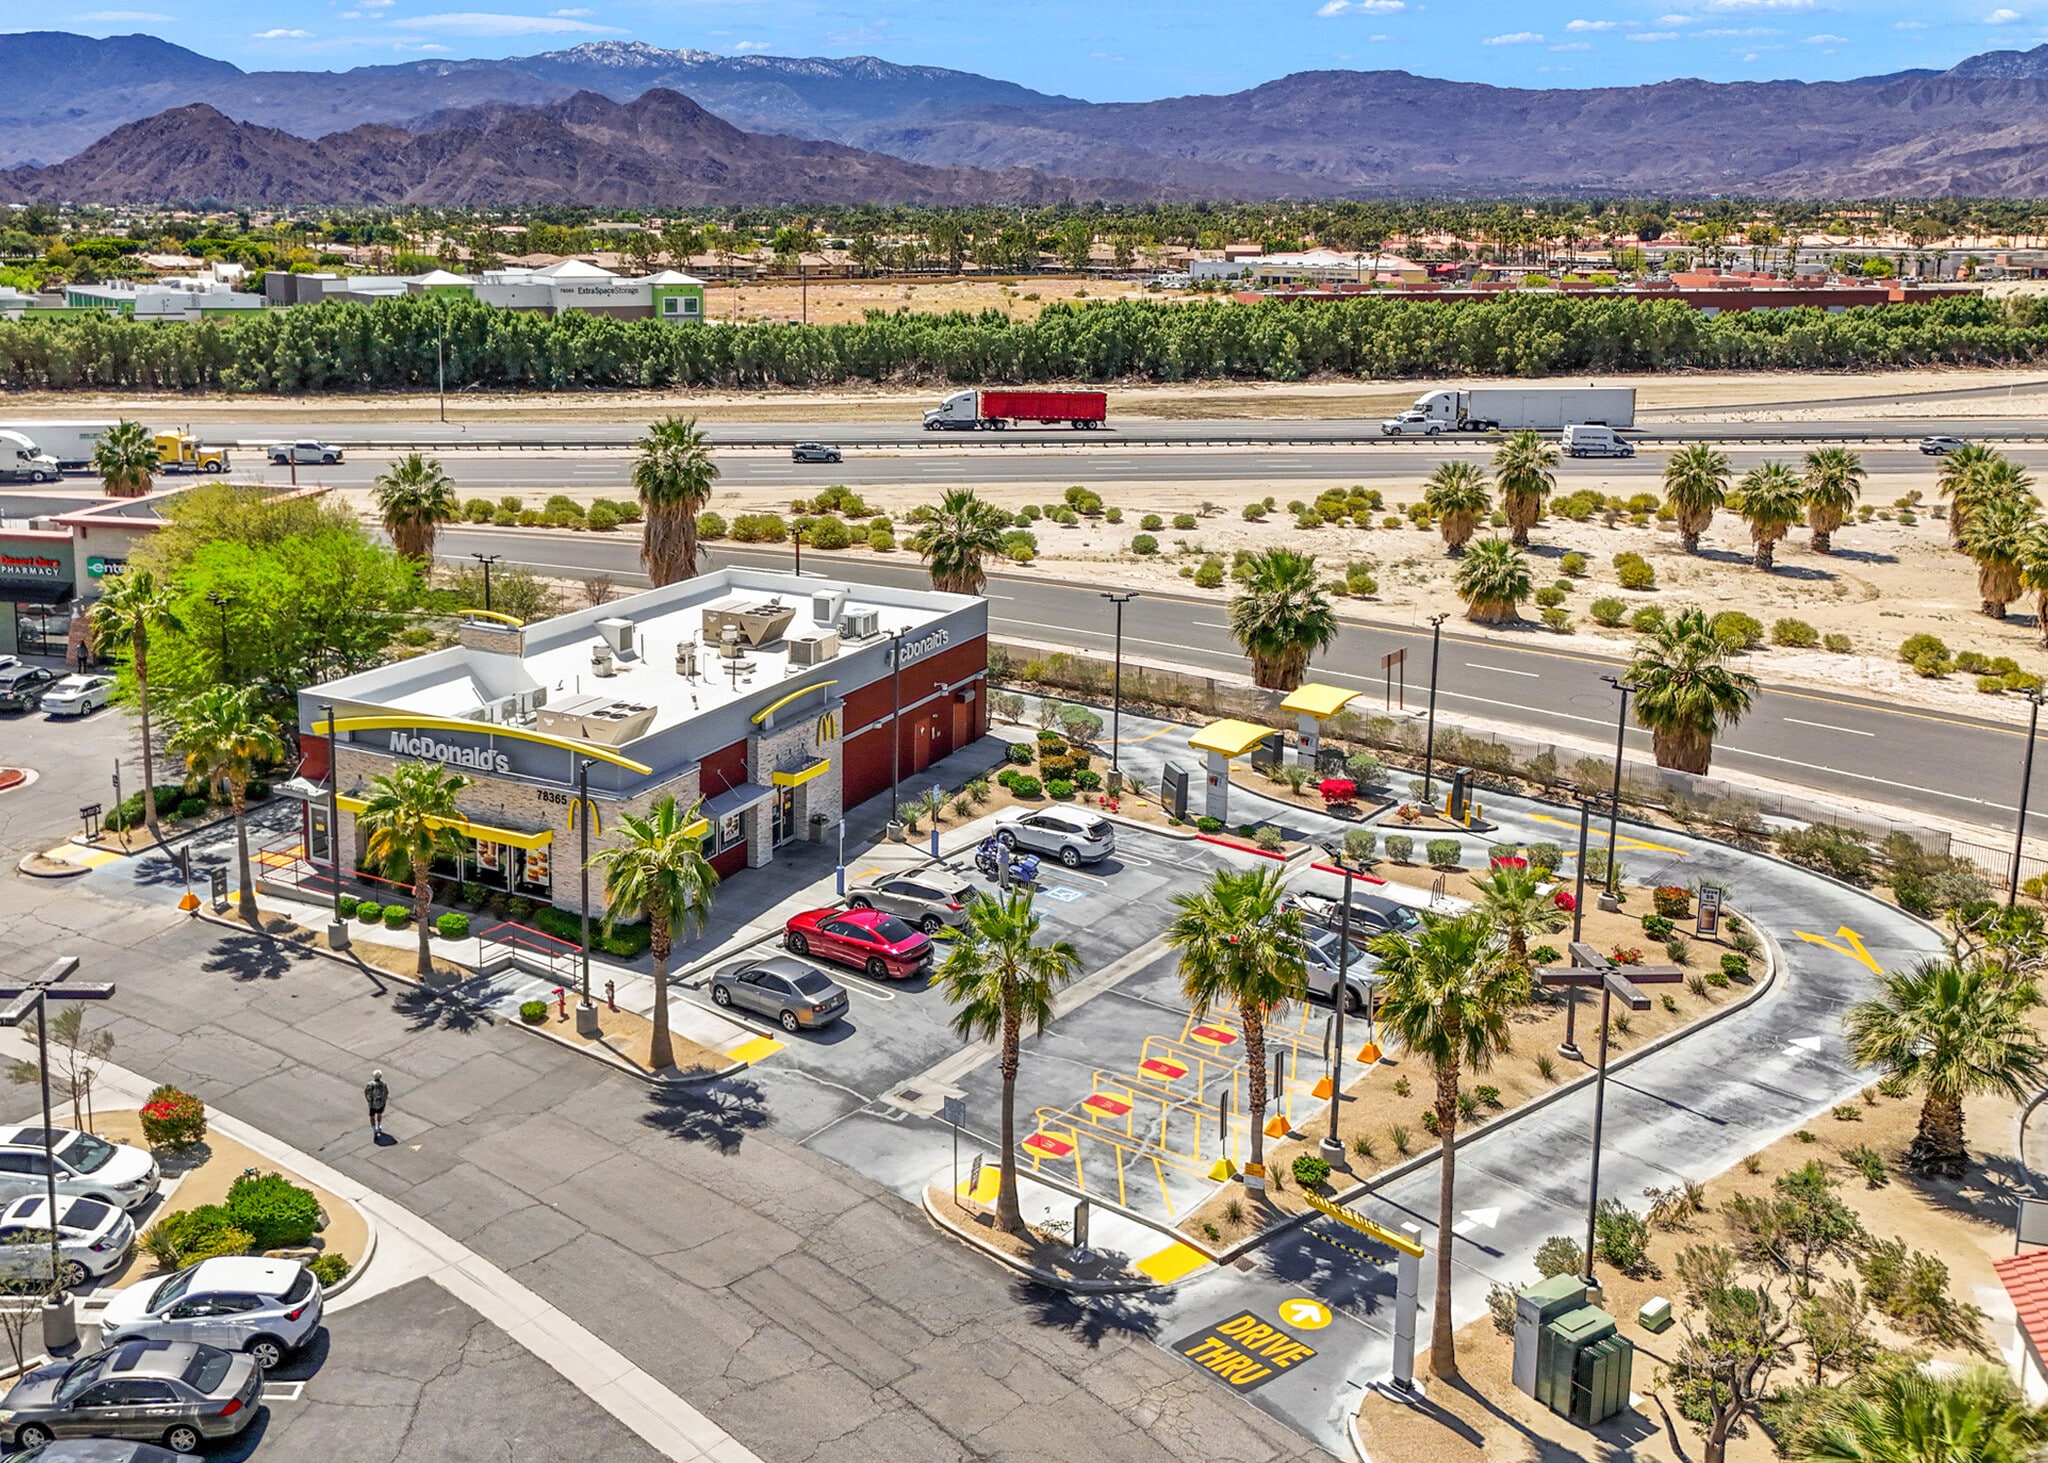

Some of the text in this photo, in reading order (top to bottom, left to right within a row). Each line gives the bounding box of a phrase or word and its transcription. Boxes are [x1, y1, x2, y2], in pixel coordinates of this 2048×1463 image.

[1, 565, 60, 577] PHARMACY
[389, 731, 510, 772] McDonald's
[537, 789, 568, 805] 78365
[1184, 1336, 1273, 1385] THRU
[1215, 1314, 1316, 1368] DRIVE
